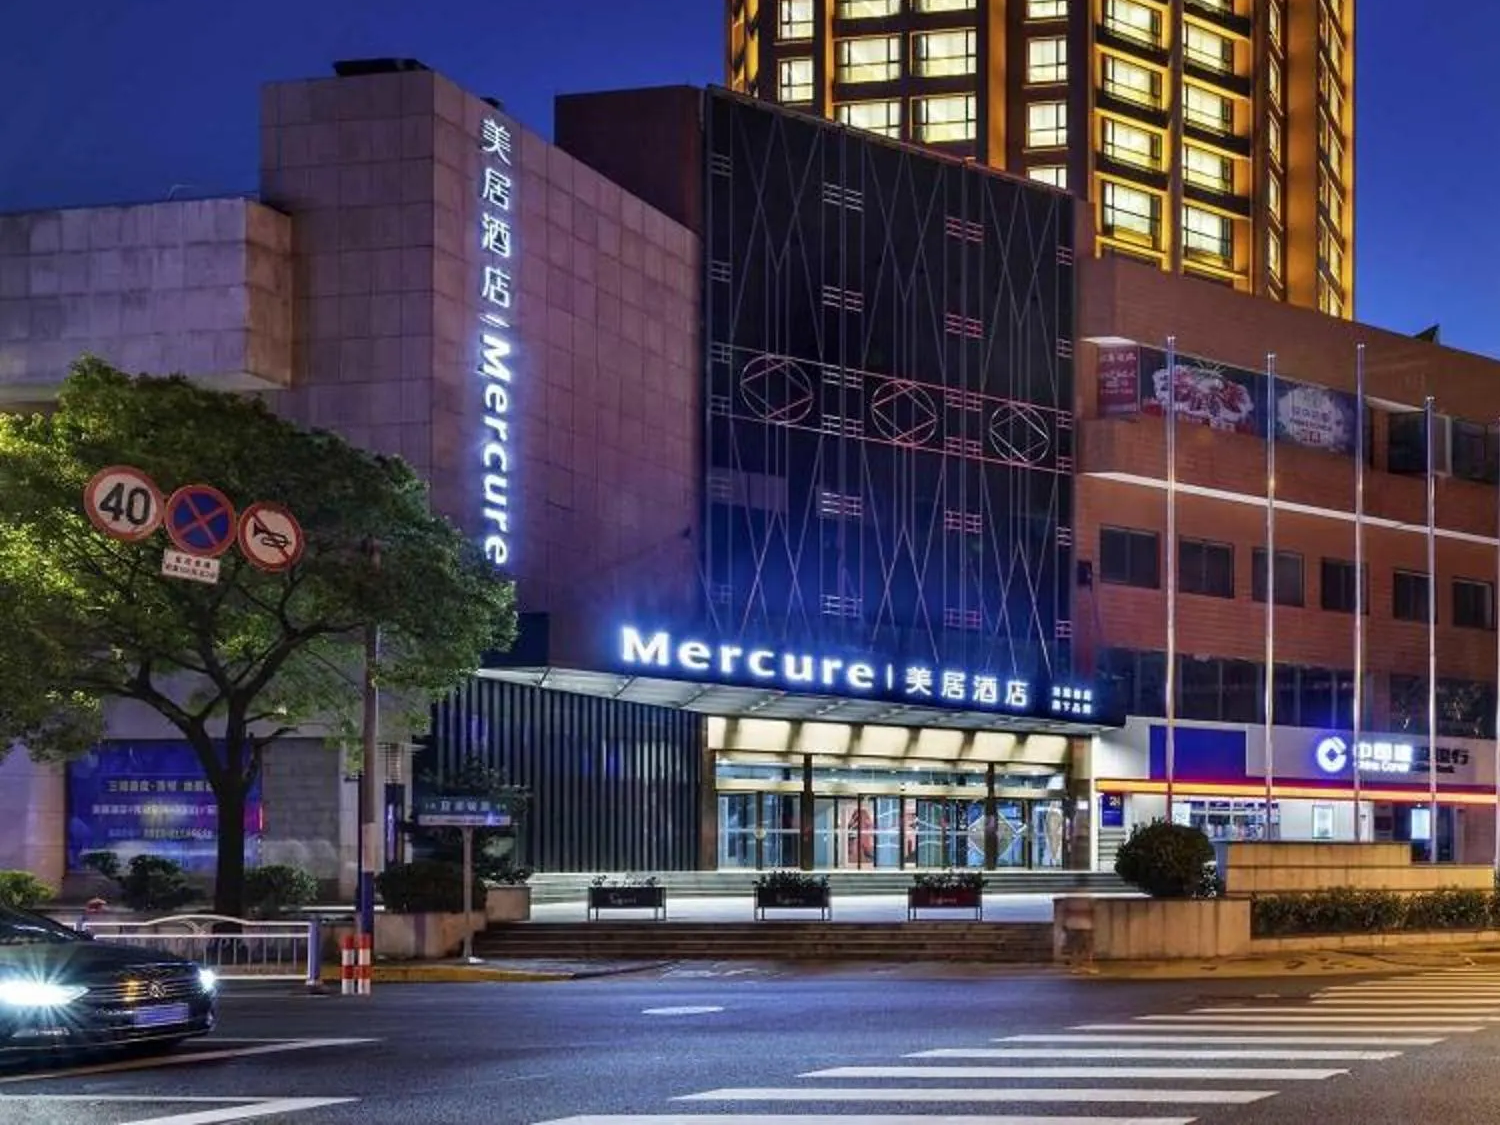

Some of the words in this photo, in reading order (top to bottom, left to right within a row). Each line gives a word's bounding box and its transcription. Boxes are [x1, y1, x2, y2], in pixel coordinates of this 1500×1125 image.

[481, 118, 512, 308] 美居酒店
[482, 333, 512, 565] Mercure
[99, 482, 151, 525] 40
[621, 626, 875, 689] Mercure
[904, 666, 1030, 707] 美居酒店
